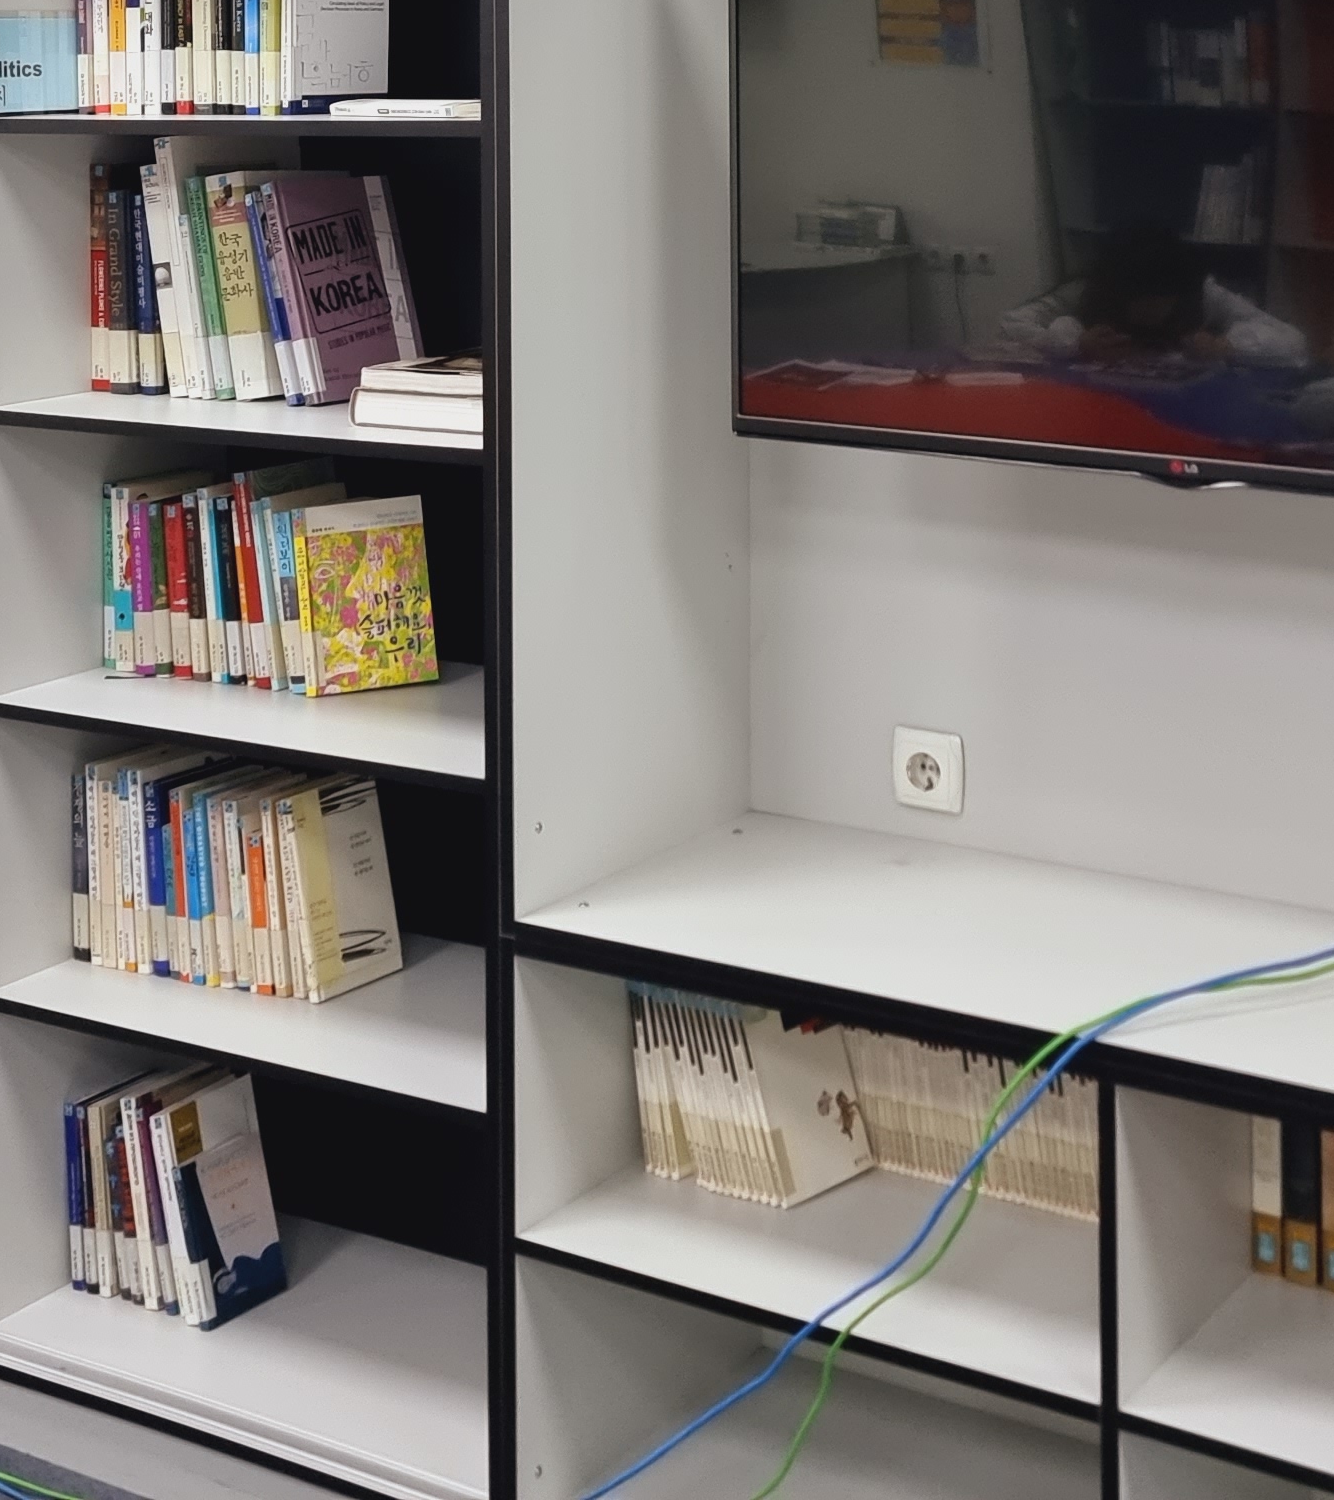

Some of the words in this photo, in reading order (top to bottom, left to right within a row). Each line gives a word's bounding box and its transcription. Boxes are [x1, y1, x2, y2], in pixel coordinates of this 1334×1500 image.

[144, 11, 154, 36] 대화
[235, 10, 243, 32] Korea
[108, 208, 119, 225] In
[108, 228, 122, 277] Grand
[218, 232, 243, 247] 한국
[269, 222, 283, 254] KOREA
[292, 222, 343, 265] MADE
[343, 216, 367, 249] IN
[109, 280, 124, 317] Style
[310, 271, 384, 317] KOREA
[385, 635, 422, 663] 우리
[143, 800, 158, 829] 소금
